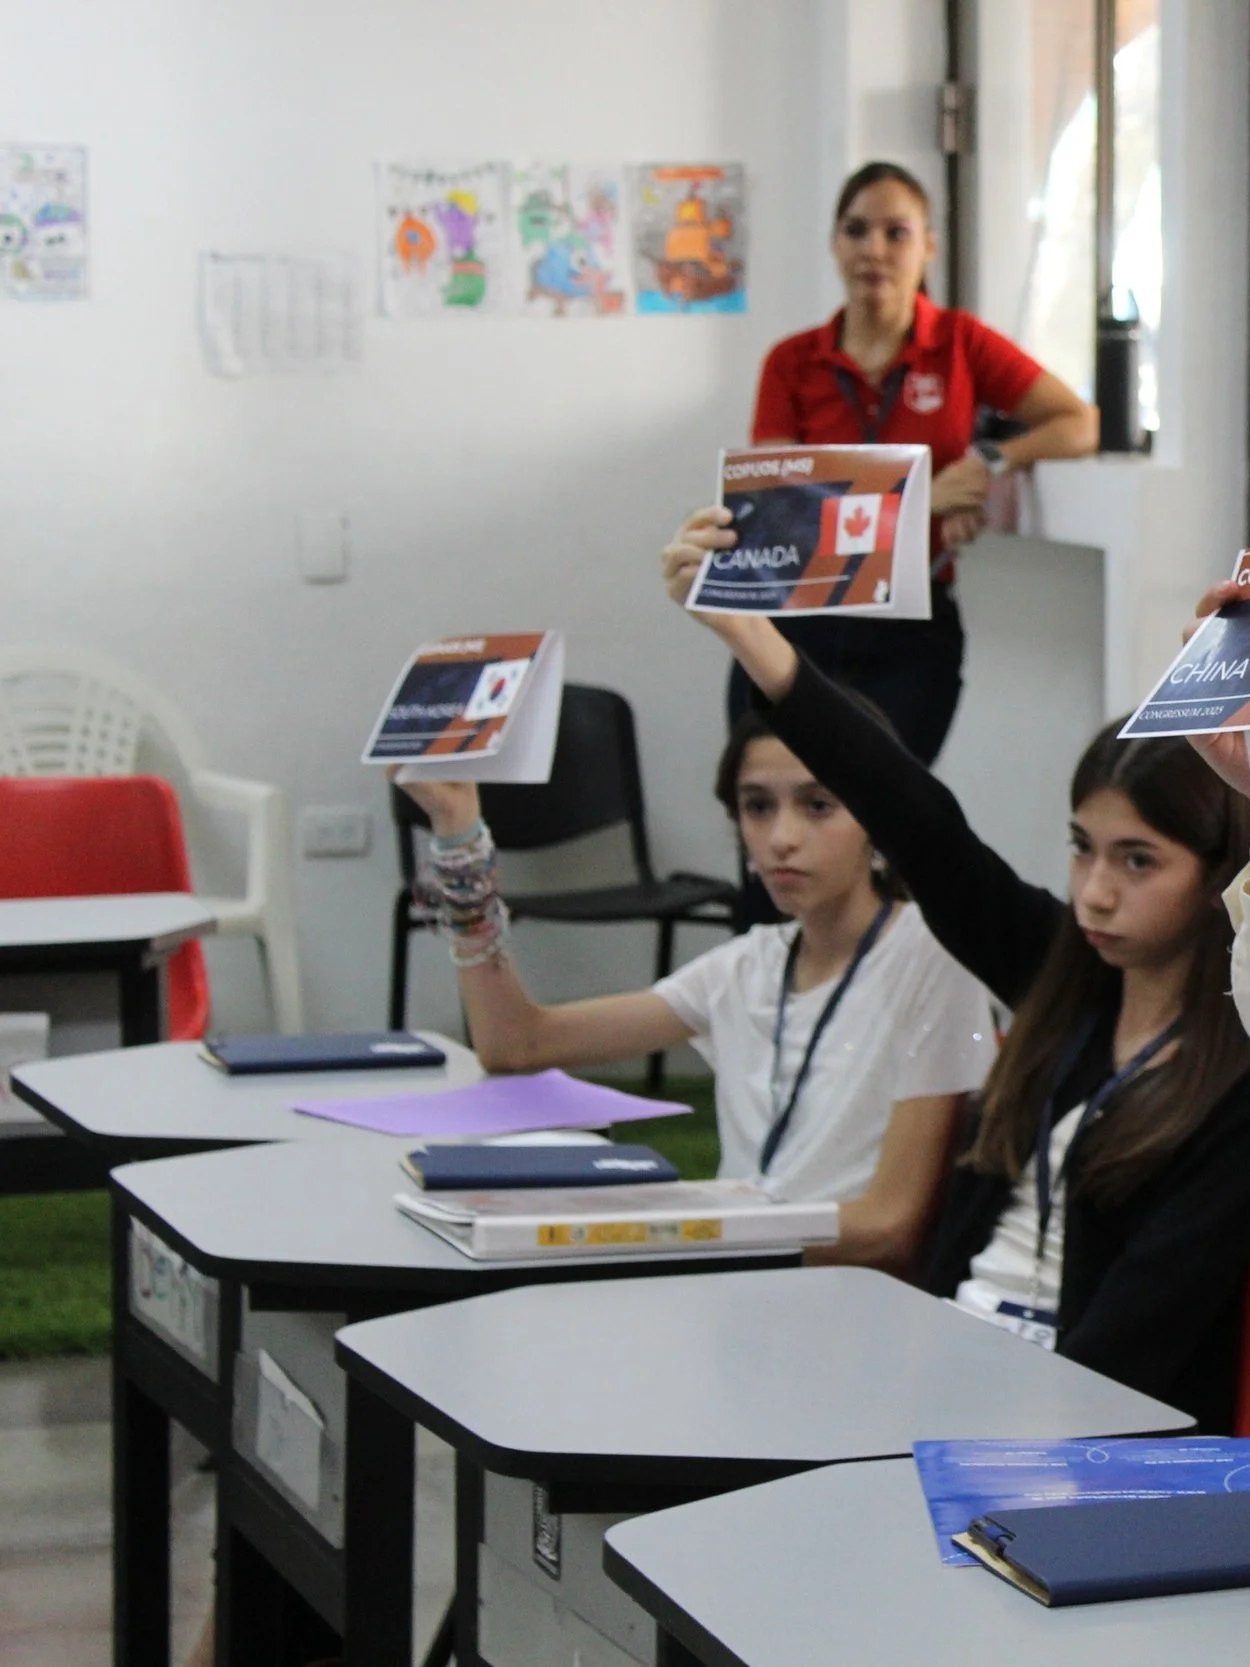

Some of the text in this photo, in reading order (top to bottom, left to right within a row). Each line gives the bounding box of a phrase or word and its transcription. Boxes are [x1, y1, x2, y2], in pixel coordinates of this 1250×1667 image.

[723, 461, 780, 480] COPUOS
[713, 544, 800, 570] CANADA
[1170, 658, 1249, 684] CHINA
